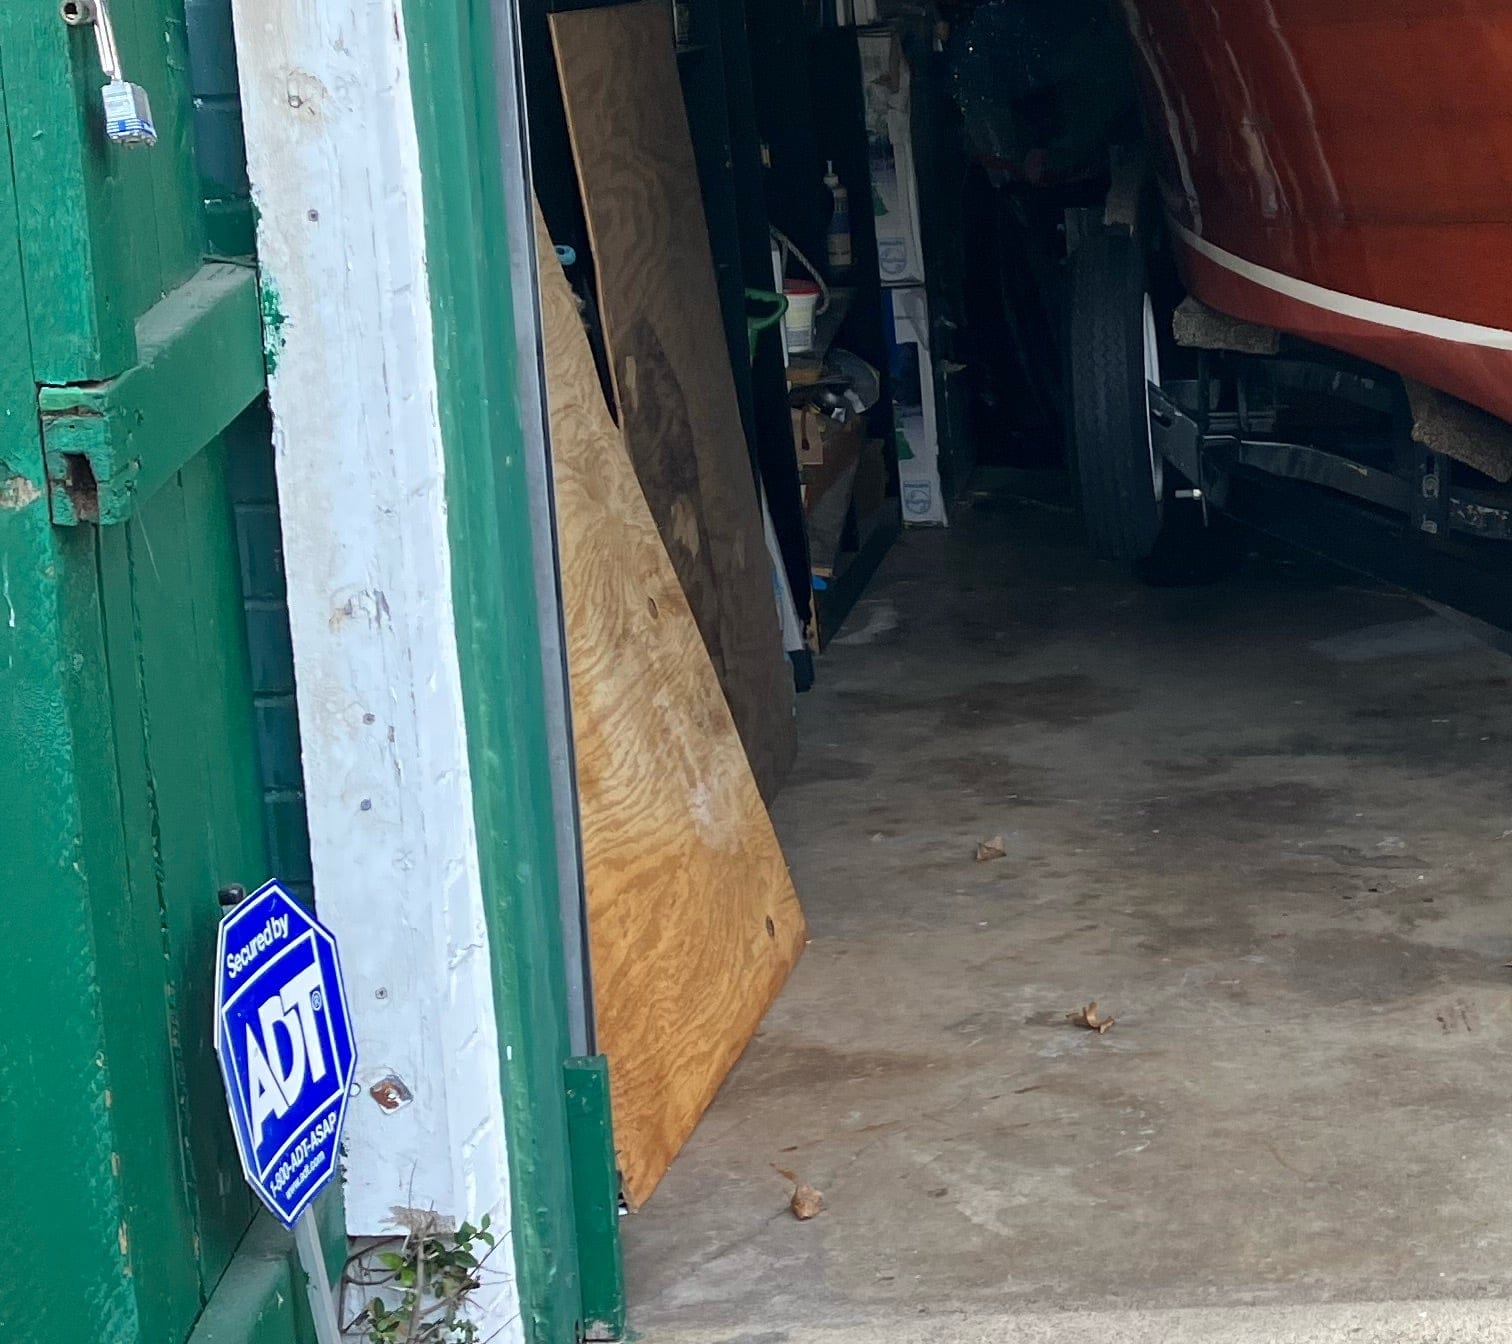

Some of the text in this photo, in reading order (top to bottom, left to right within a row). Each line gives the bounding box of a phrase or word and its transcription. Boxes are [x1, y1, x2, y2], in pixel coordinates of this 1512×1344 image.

[226, 913, 289, 979] Secured by
[269, 1111, 337, 1199] 1-800-ADT-ASAP
[285, 1150, 325, 1201] www.adt.com
